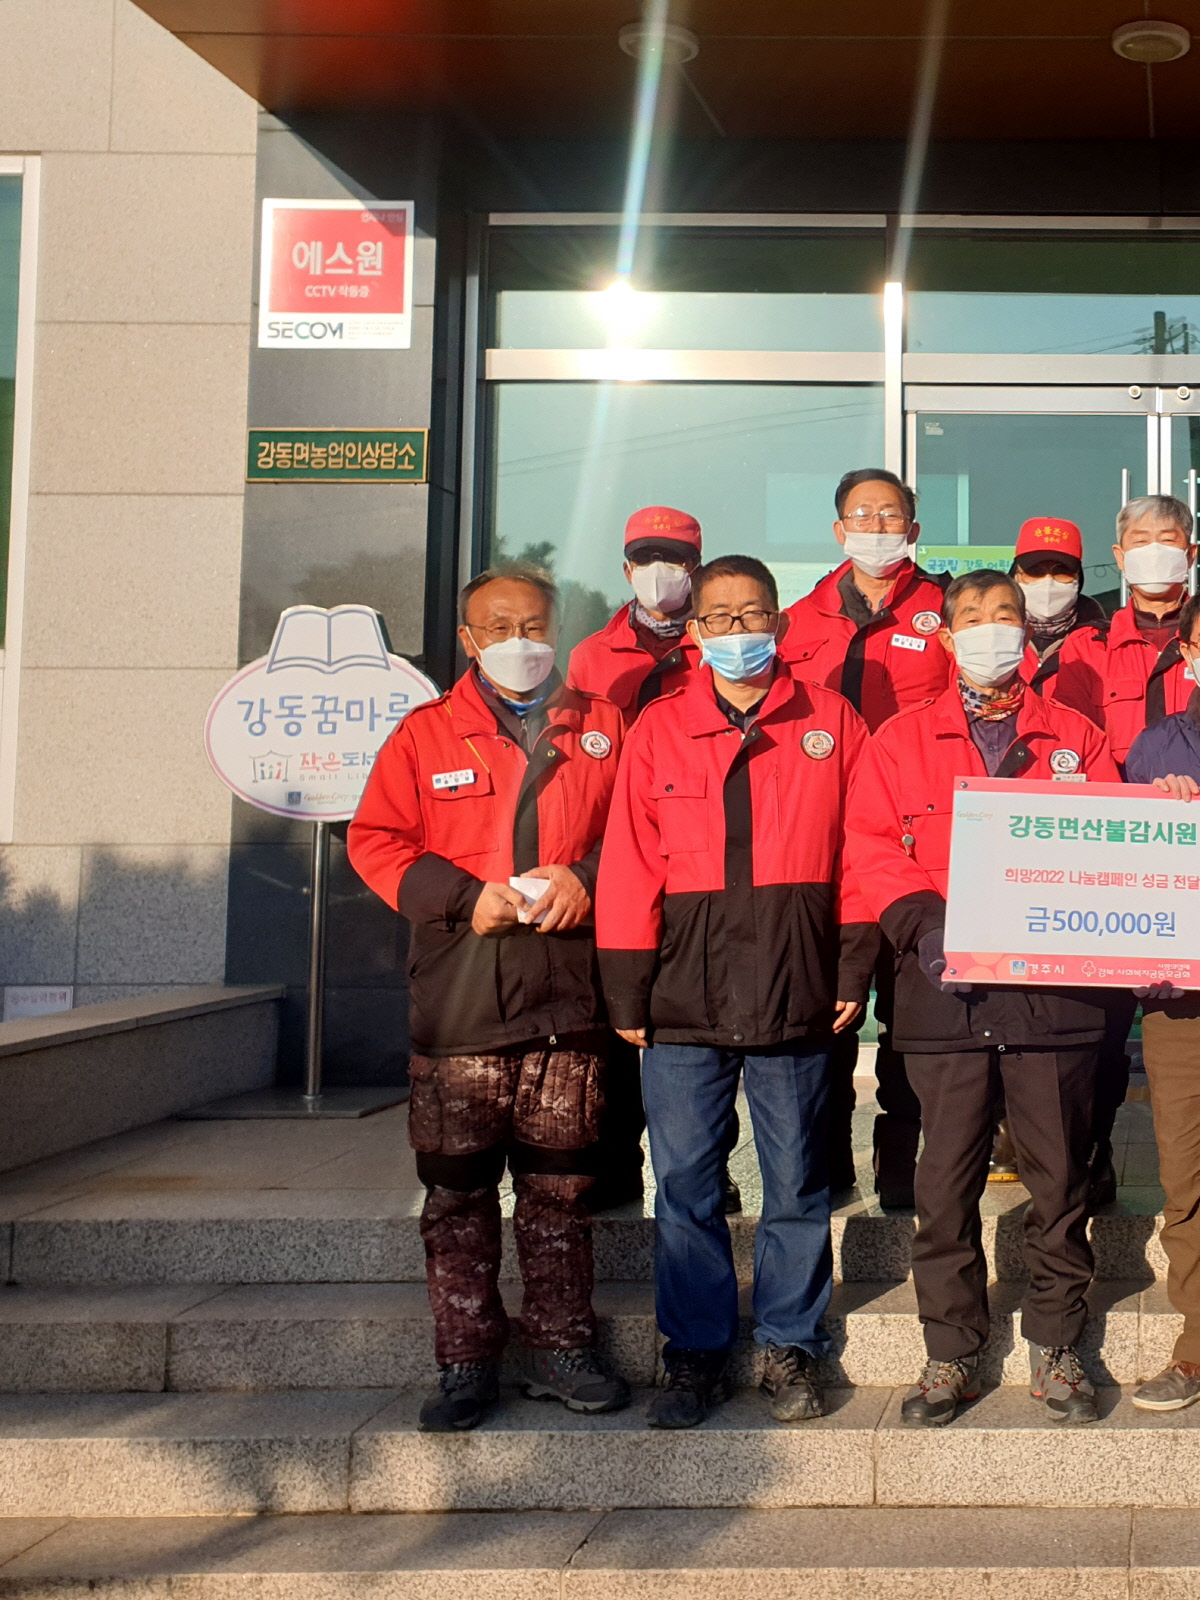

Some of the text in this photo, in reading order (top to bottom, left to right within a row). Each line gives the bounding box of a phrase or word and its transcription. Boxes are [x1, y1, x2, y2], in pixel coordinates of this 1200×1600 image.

[291, 241, 383, 276] 에스원
[304, 285, 370, 299] CCTV 작동중
[267, 322, 344, 340] SECOM
[257, 440, 416, 471] 강동면농업인상담소
[927, 559, 959, 572] 국공립
[237, 693, 411, 737] 강동꿈마루
[1008, 815, 1198, 846] 강동면산불감시원
[1004, 868, 1200, 890] 희망2022 나눔캠페인 성금 전달
[1025, 907, 1177, 938] 금500,000원
[1028, 963, 1065, 975] 경주시
[1097, 967, 1115, 977] 경북
